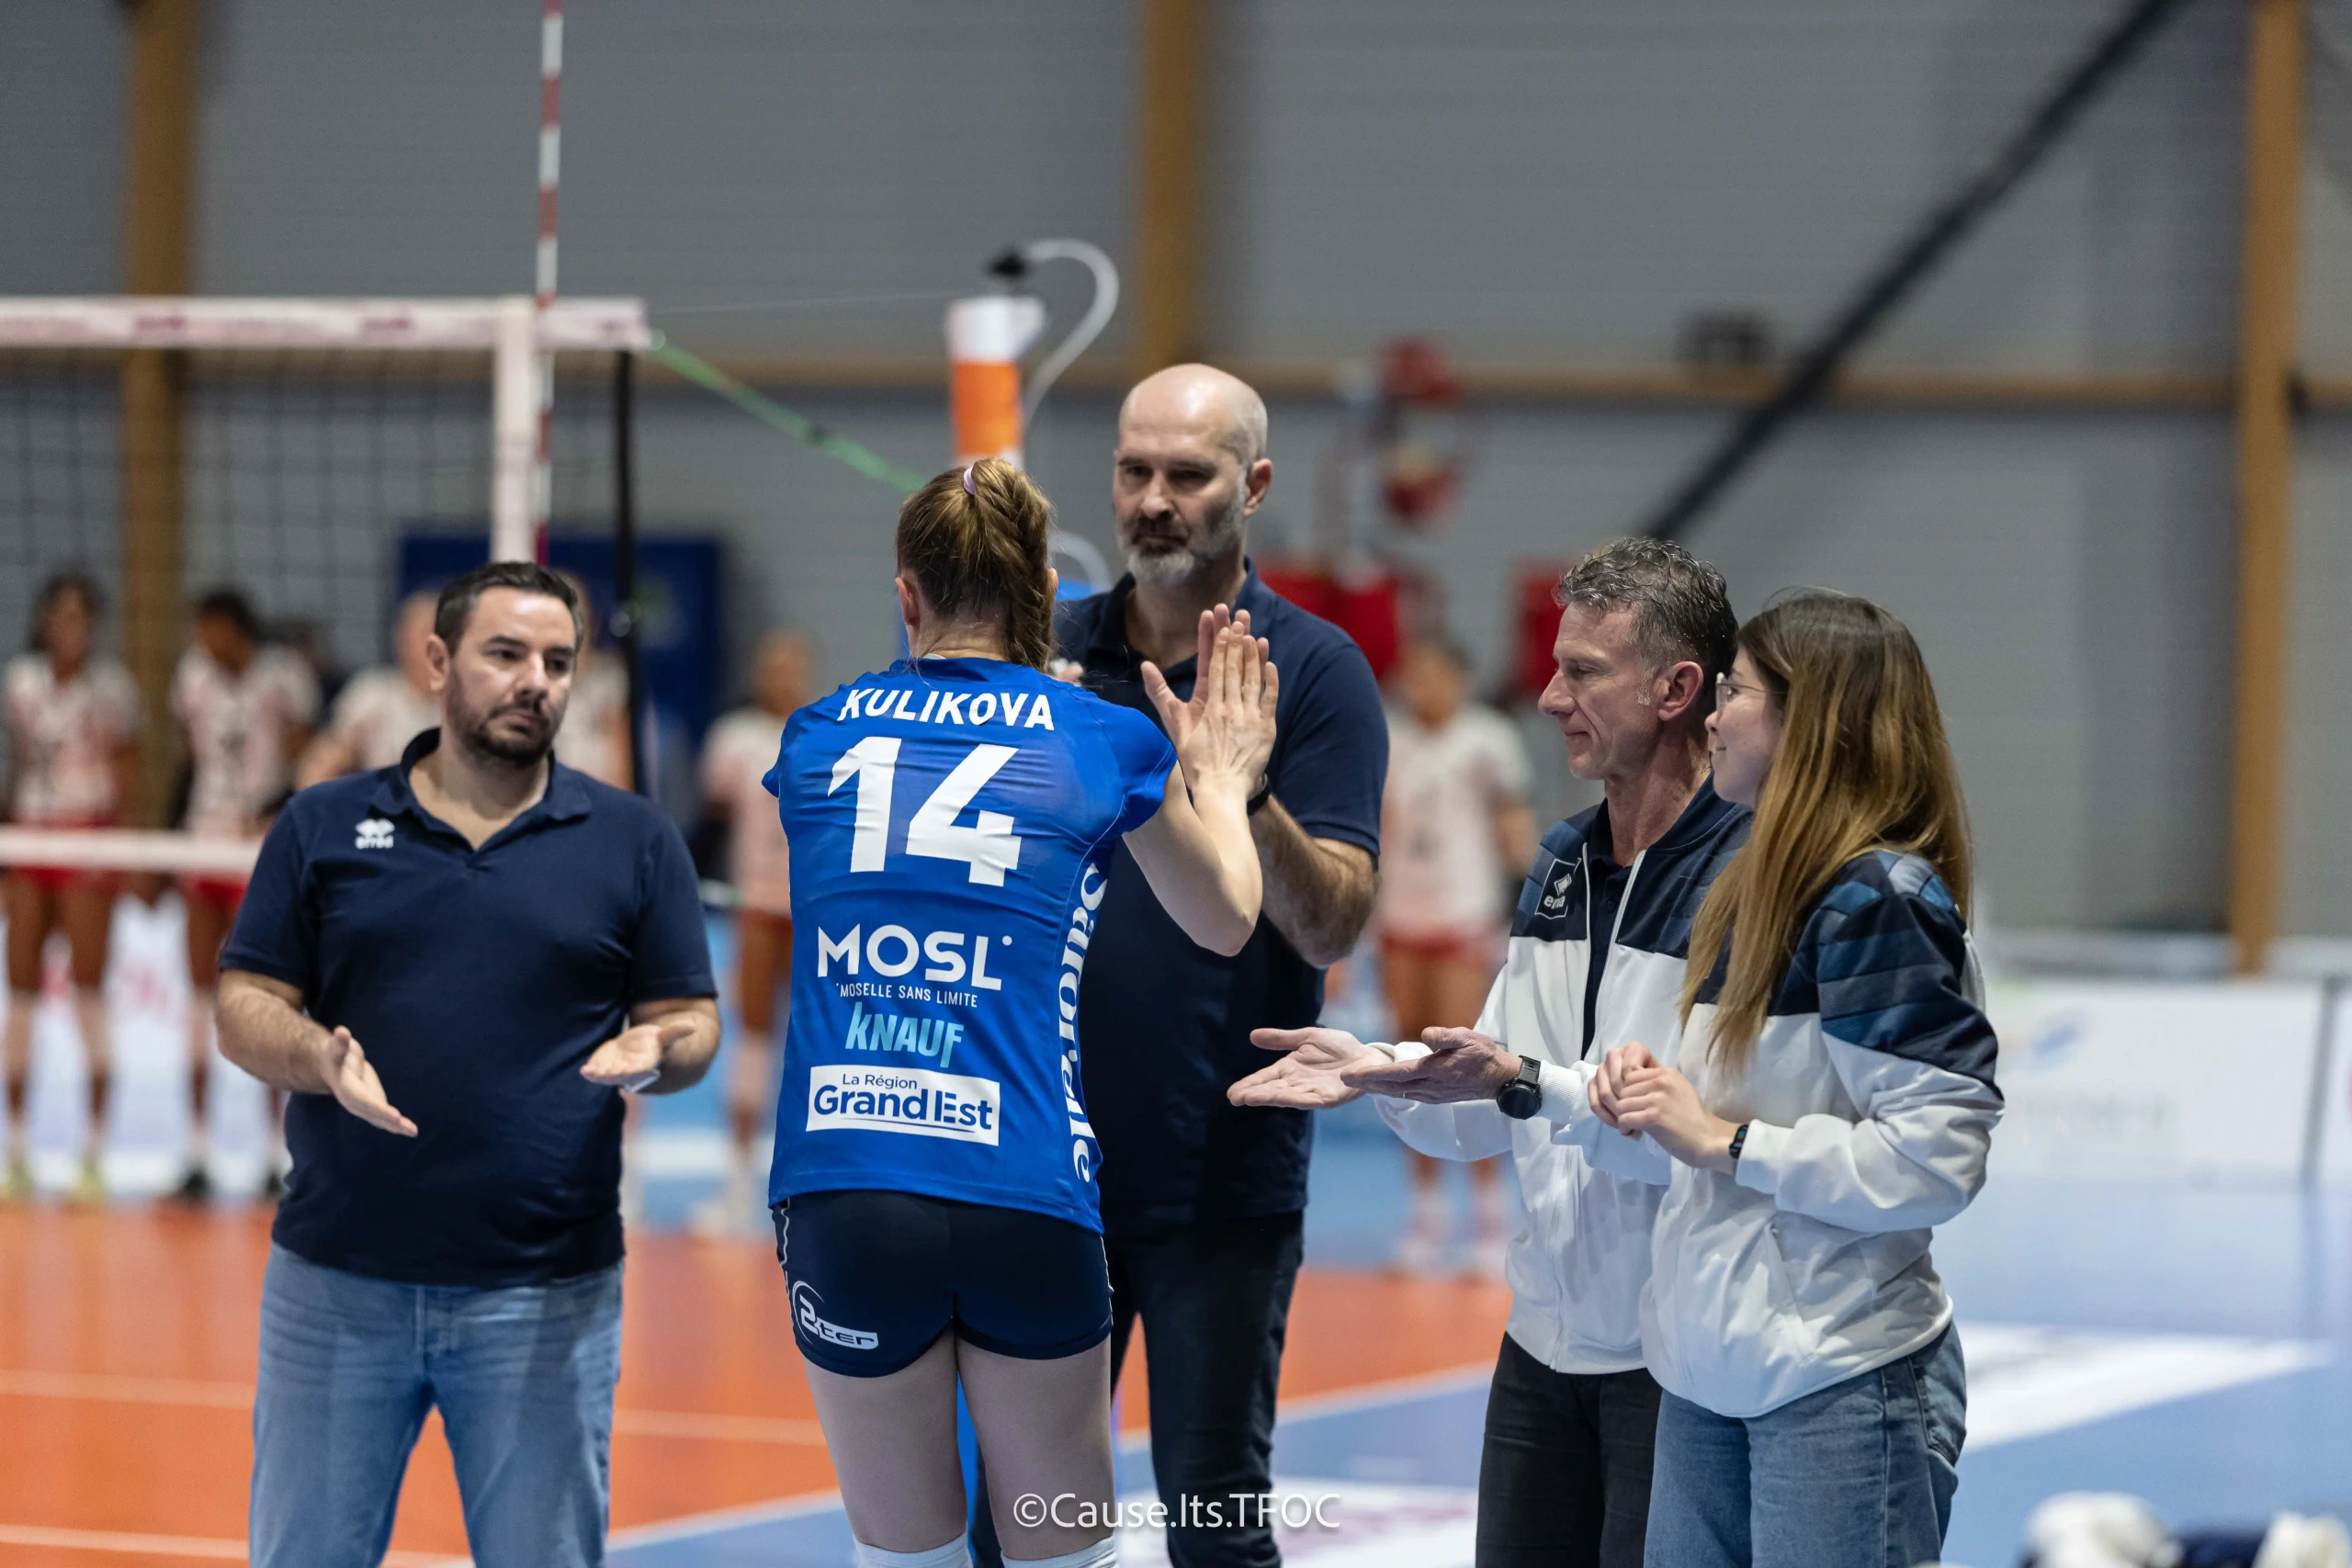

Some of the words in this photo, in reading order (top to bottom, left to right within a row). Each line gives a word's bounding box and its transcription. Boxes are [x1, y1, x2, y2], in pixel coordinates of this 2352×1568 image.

[837, 687, 1055, 731] KULIKOVA
[827, 736, 1023, 887] 14
[840, 982, 893, 998] MOSELLE
[898, 985, 932, 1002] SANS
[936, 989, 978, 1009] LIMITE
[844, 1000, 965, 1068] KNAUF
[842, 1073, 860, 1086] La
[865, 1073, 918, 1090] Région
